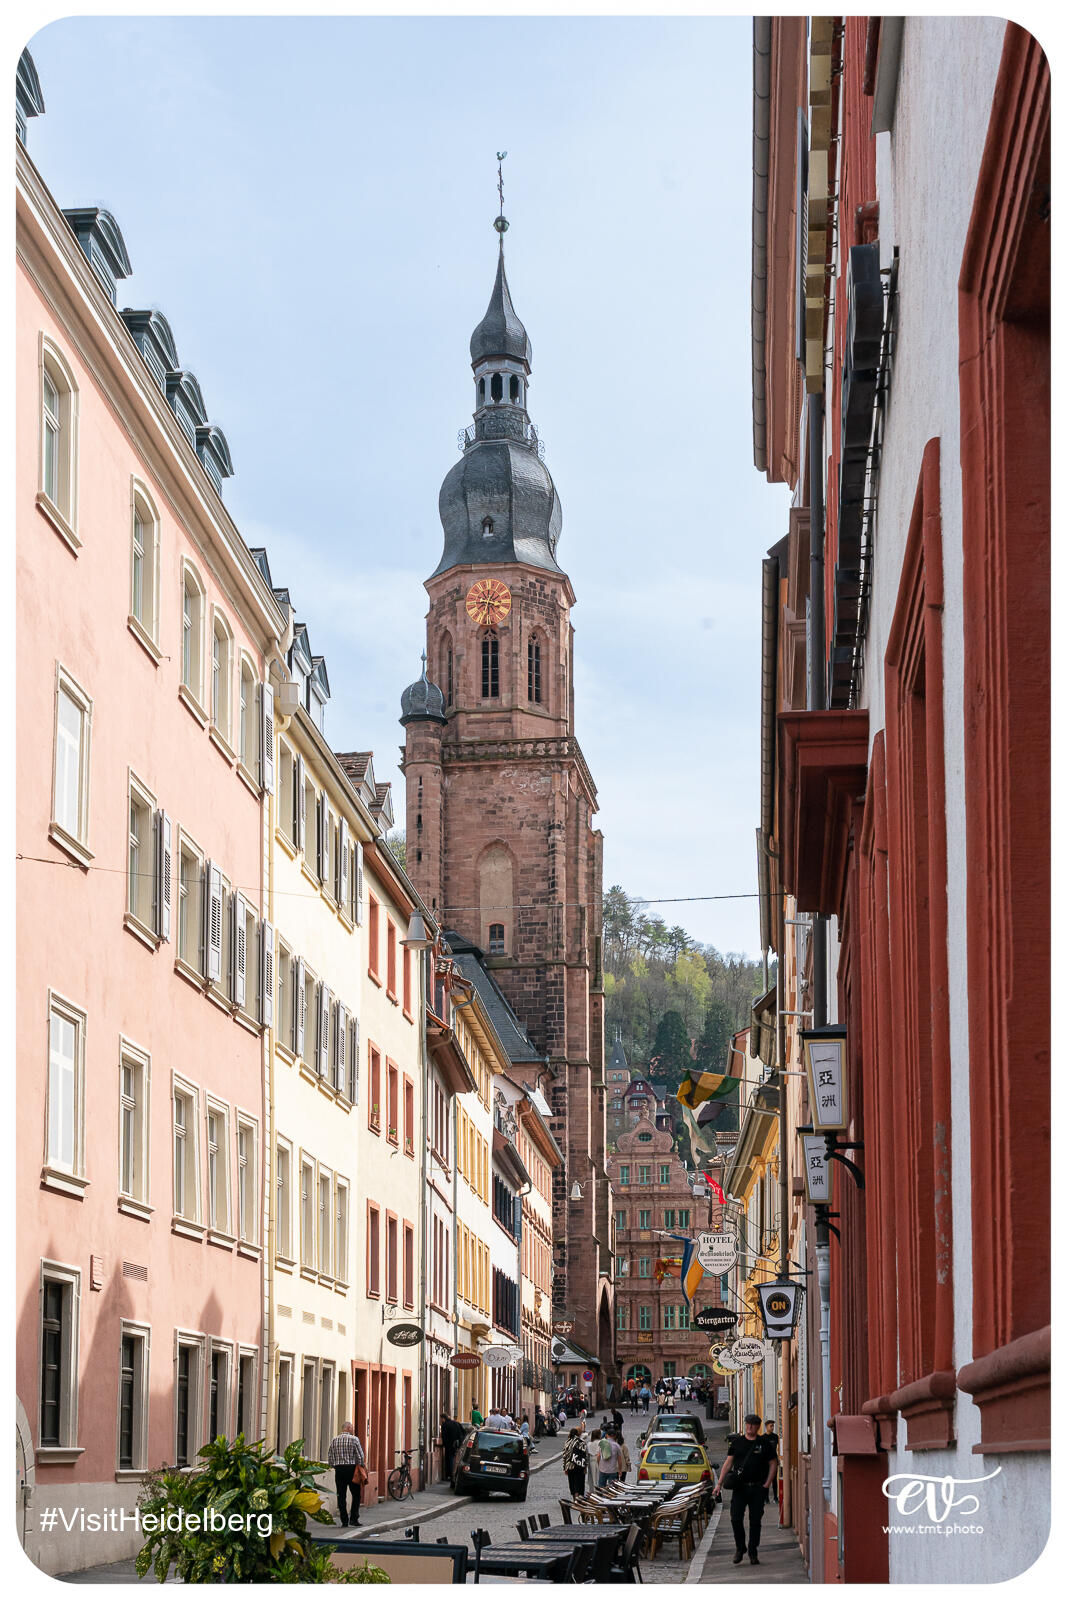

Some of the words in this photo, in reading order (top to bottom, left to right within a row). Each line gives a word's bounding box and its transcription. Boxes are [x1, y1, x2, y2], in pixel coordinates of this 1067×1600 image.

[703, 1236, 733, 1244] HOTEL
[771, 1300, 786, 1311] ON
[697, 1316, 736, 1326] Biergarten
